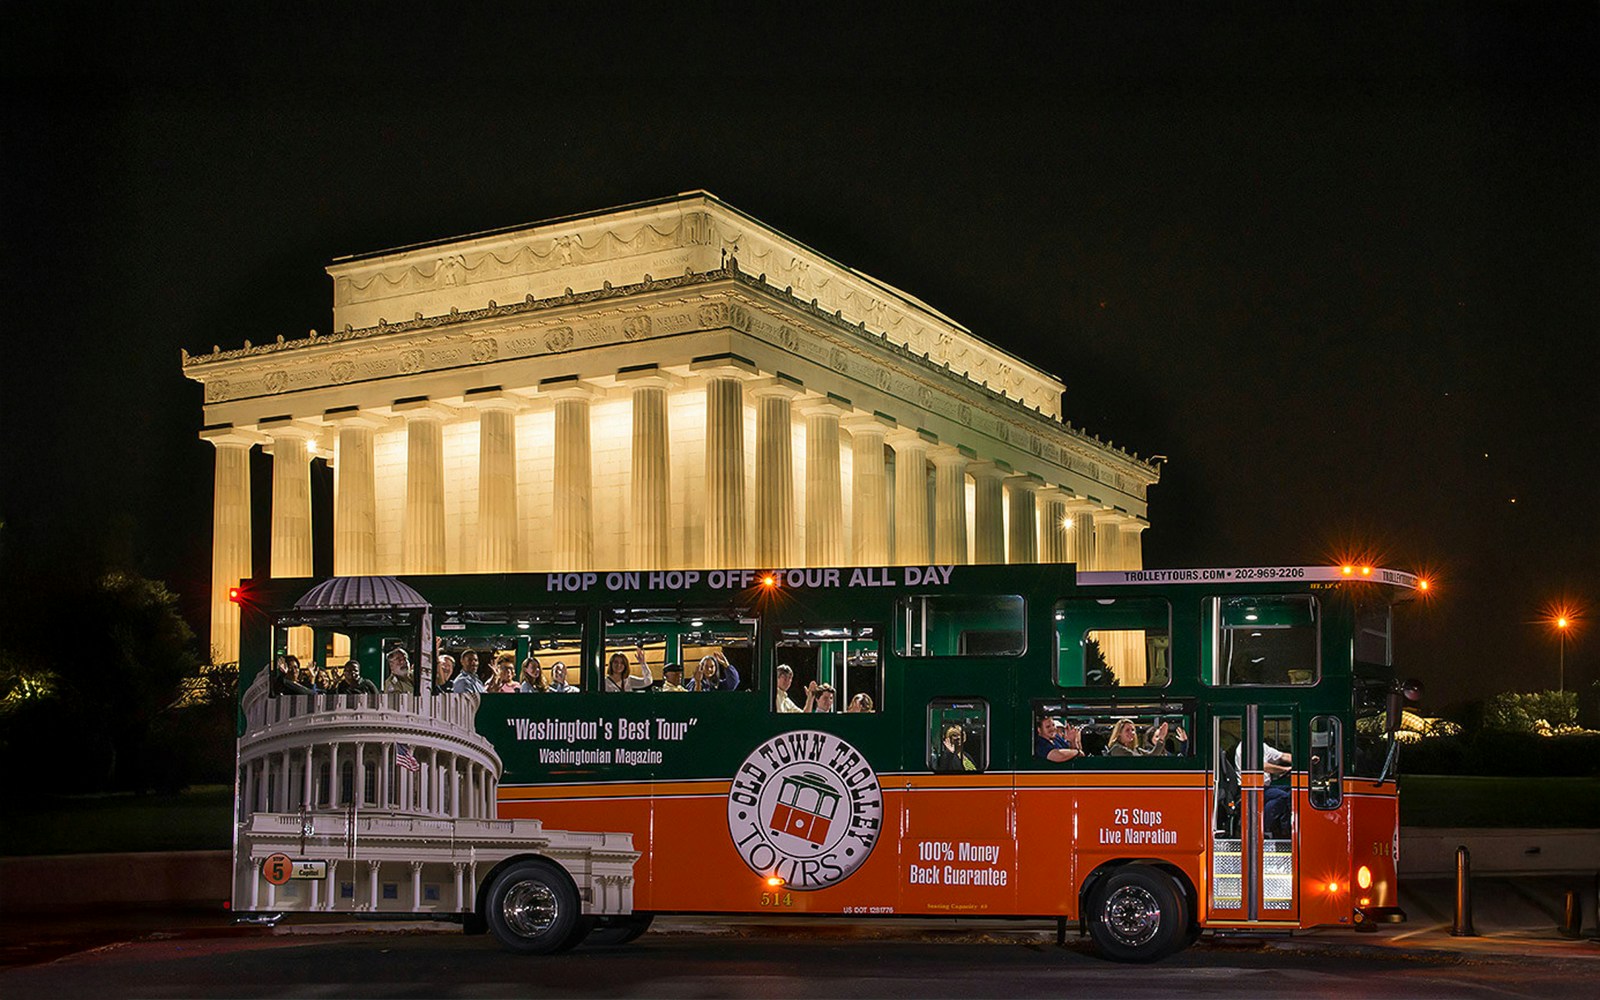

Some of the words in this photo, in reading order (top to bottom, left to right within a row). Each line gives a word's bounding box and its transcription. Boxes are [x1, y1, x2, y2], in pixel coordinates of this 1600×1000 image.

[547, 573, 597, 591] HOP
[606, 572, 640, 591] ON
[649, 571, 700, 590] HOP
[708, 570, 755, 589] OFF
[774, 568, 840, 588] TOUR
[849, 567, 896, 587] ALL
[905, 566, 954, 586] DAY
[1235, 568, 1305, 579] 202-969-2206
[619, 718, 650, 740] Best
[656, 718, 698, 740] Tour"
[540, 749, 611, 766] Washingtonian
[615, 749, 663, 766] Magazine
[732, 762, 767, 807] OLD
[759, 733, 827, 769] TOWN
[828, 741, 880, 849] TROLLEY
[1114, 809, 1129, 824] 25
[1132, 808, 1162, 826] Stops
[1100, 829, 1121, 844] Live
[1125, 829, 1177, 844] Narration
[738, 822, 843, 887] TOURS
[918, 841, 955, 861] 100%
[958, 842, 999, 865] Money
[1373, 842, 1390, 856] 514
[273, 863, 283, 881] 5
[910, 864, 940, 885] Back
[944, 865, 1007, 887] Guarantee
[761, 893, 792, 906] 514
[843, 906, 853, 914] US
[854, 906, 867, 914] DOT
